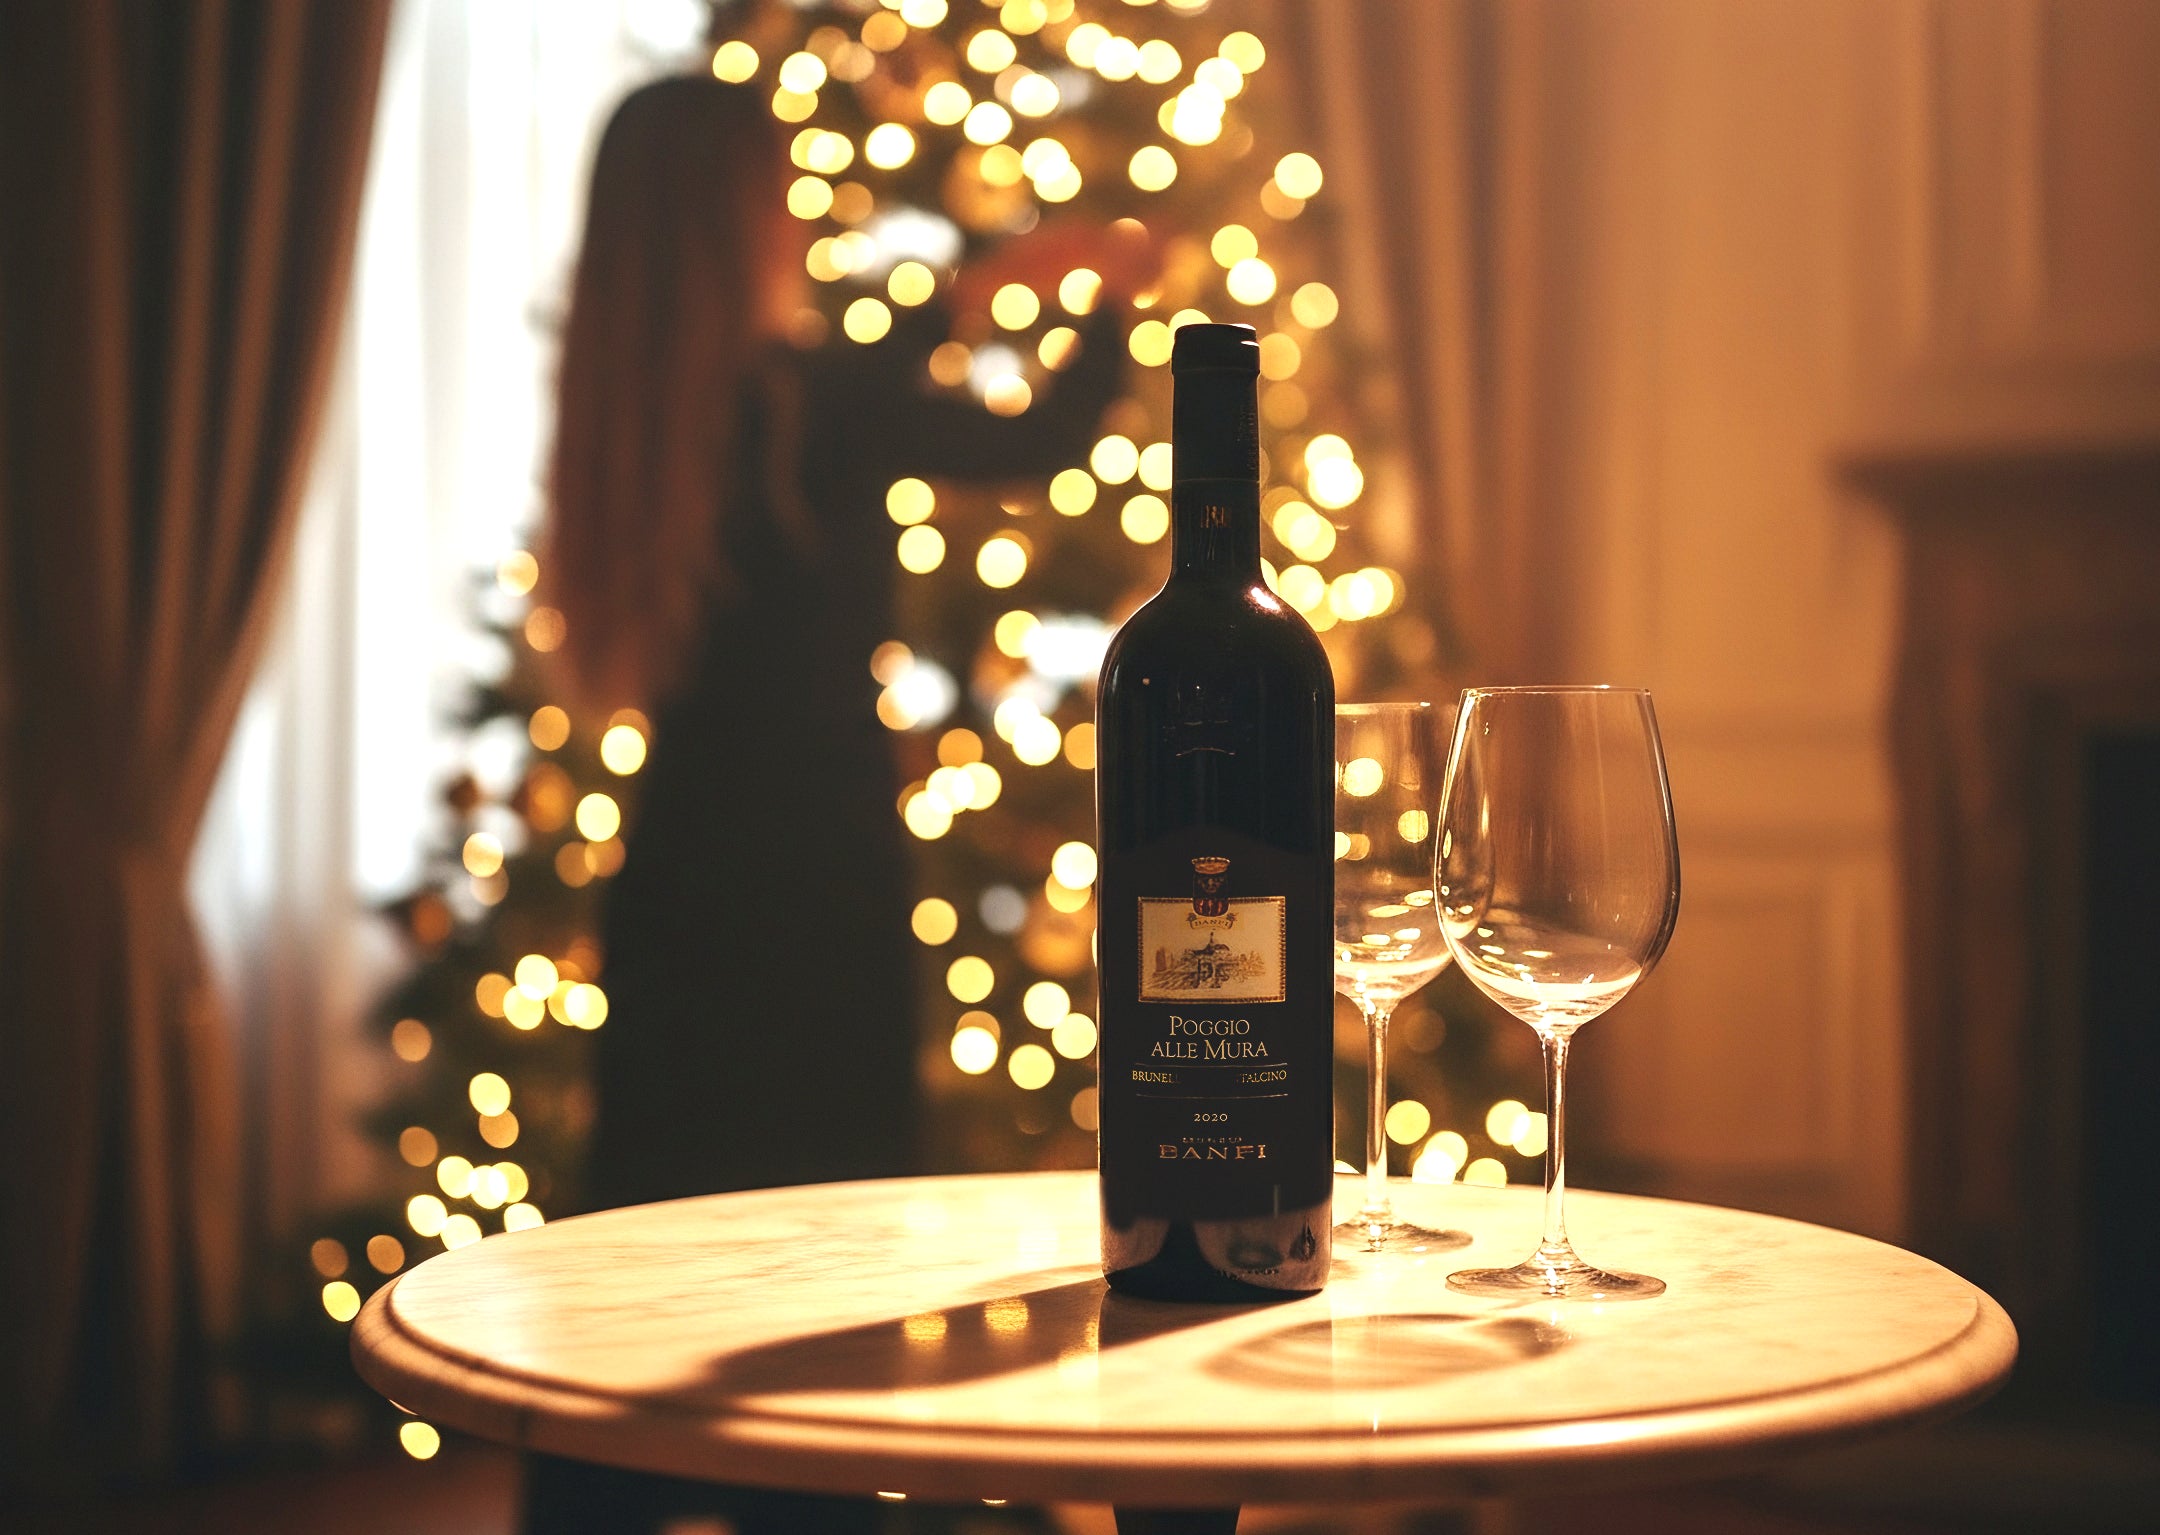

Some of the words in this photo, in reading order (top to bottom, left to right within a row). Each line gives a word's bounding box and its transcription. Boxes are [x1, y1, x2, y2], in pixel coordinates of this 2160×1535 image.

[1169, 1015, 1250, 1036] POGGIO
[1151, 1041, 1199, 1059] ALLE
[1203, 1039, 1269, 1060] MURA
[1241, 1069, 1287, 1084] TALCINO
[1193, 1113, 1228, 1122] 2020
[1159, 1144, 1267, 1160] BANFI
